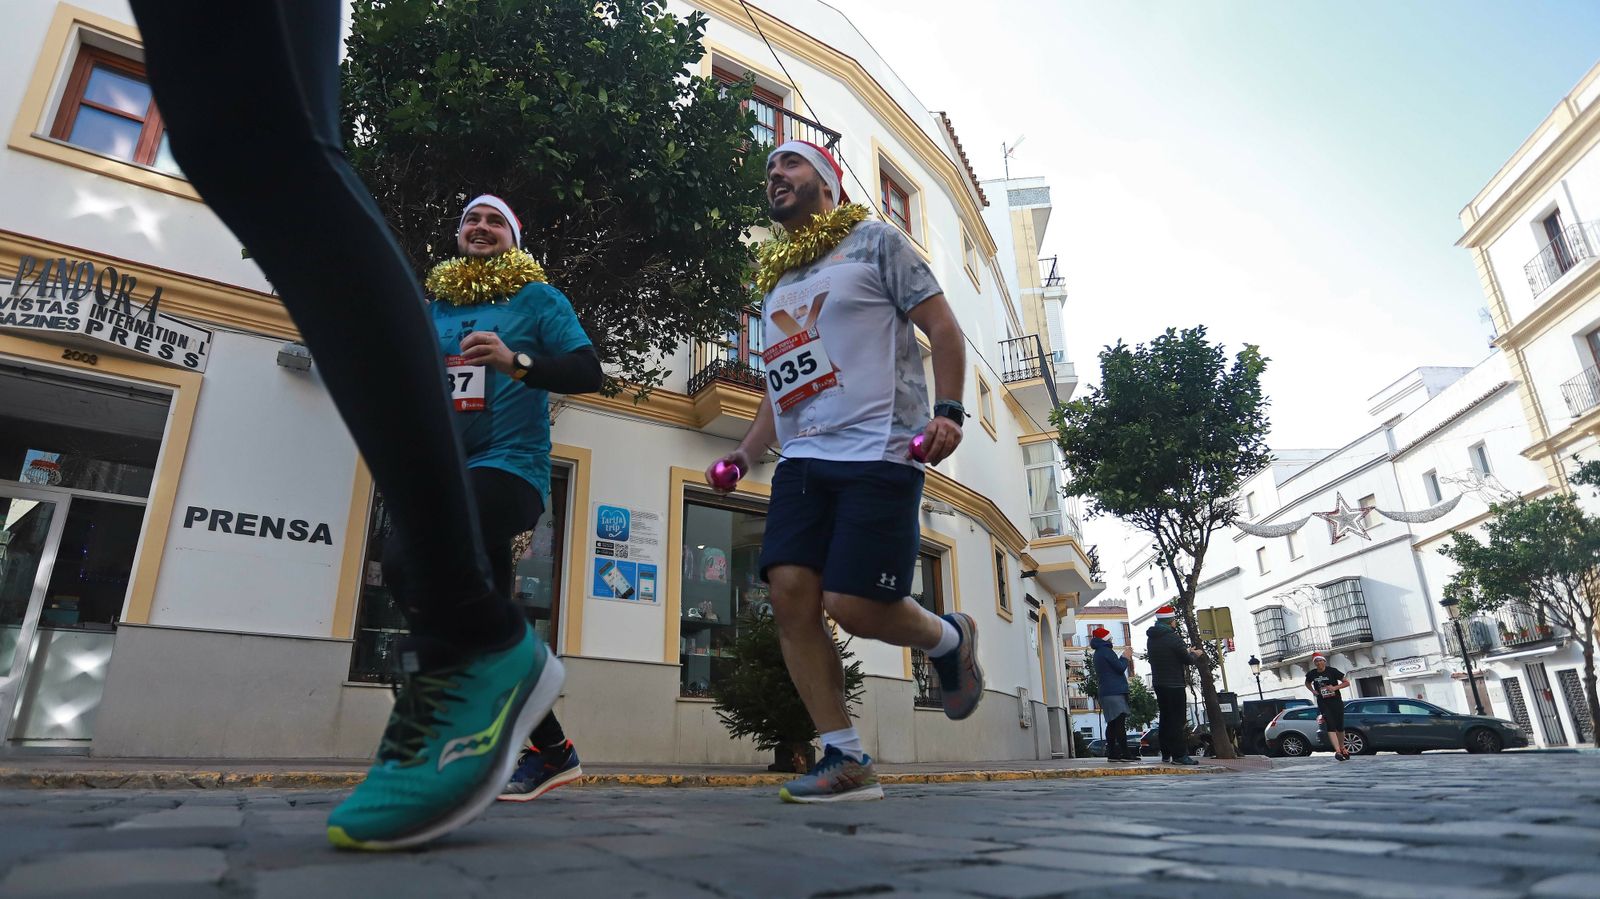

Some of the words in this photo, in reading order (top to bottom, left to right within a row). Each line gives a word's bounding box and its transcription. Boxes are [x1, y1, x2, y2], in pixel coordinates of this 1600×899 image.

[11, 255, 163, 323] PANDORA
[85, 318, 199, 368] PRESS
[769, 350, 817, 392] 035
[183, 505, 333, 545] PRENSA
